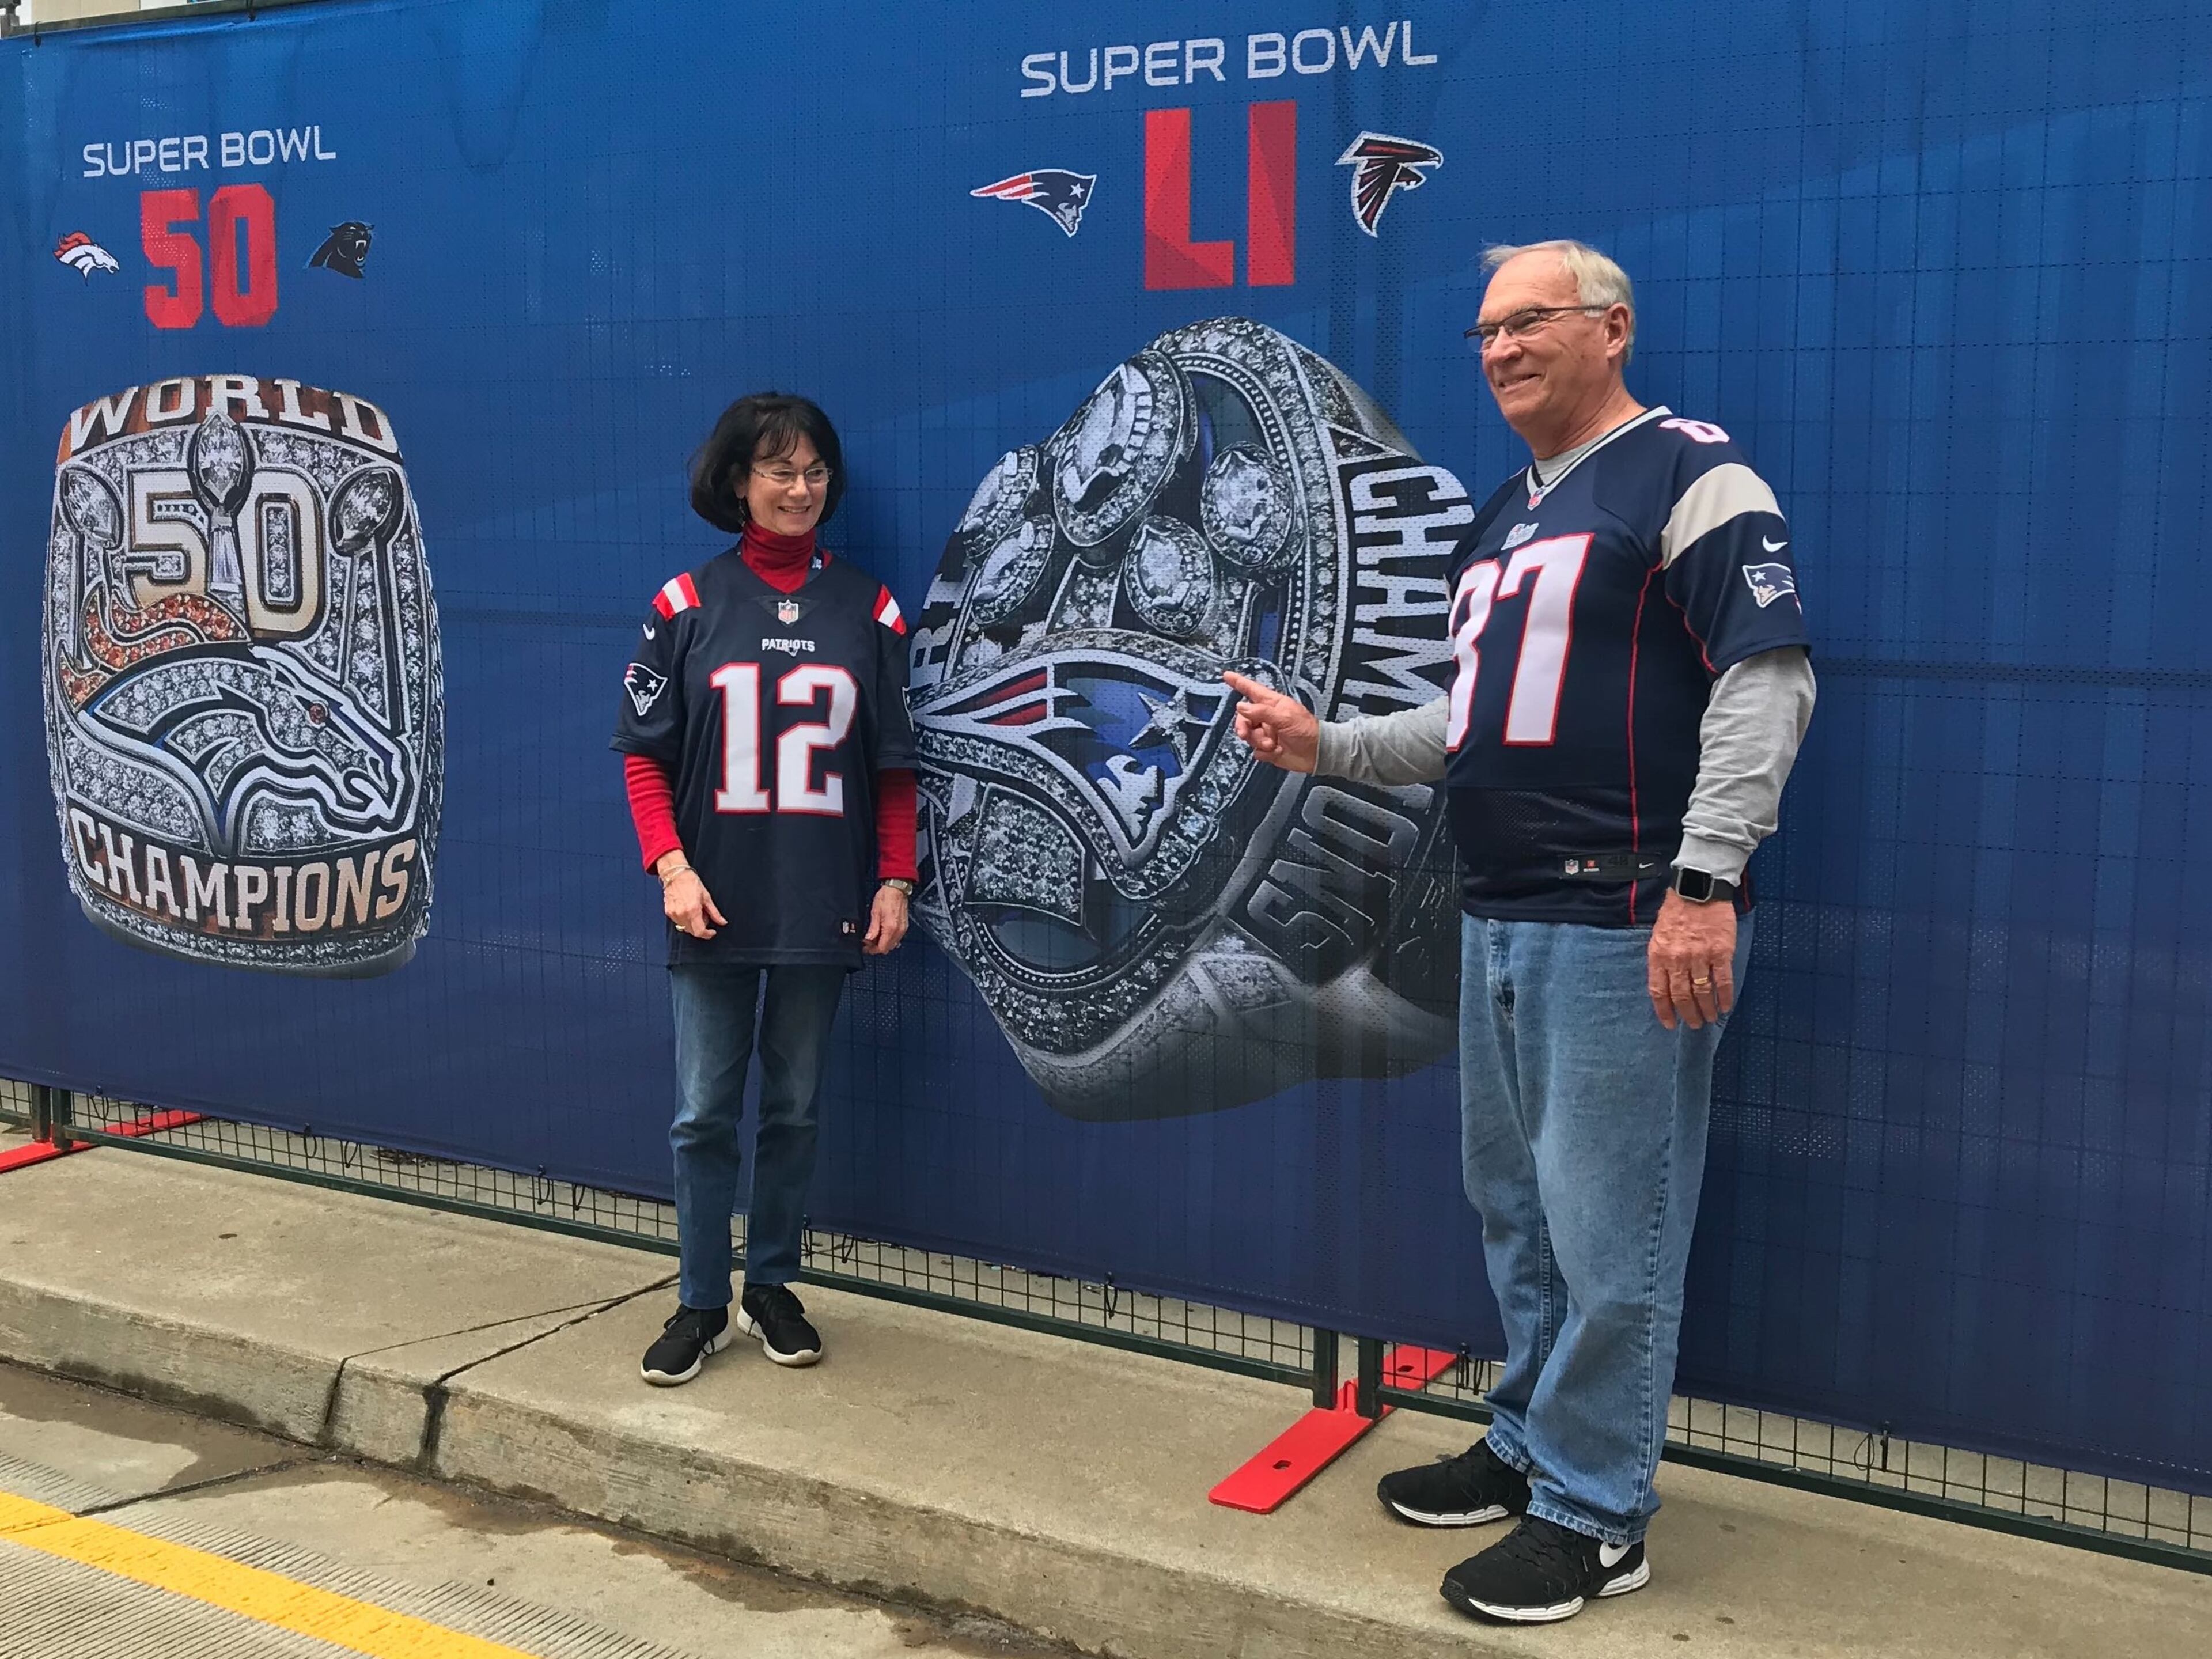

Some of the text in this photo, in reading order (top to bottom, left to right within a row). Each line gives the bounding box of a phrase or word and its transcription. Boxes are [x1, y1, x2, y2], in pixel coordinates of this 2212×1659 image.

[1020, 20, 1438, 98] SUPER BOWL
[83, 124, 337, 177] SUPER BOWL
[1144, 100, 1297, 290] LI
[140, 183, 279, 329] 50
[69, 374, 403, 454] WORLD
[126, 463, 324, 634] 50
[762, 638, 816, 652] PATRIOTS
[1445, 532, 1595, 752] 87
[709, 662, 858, 817] 12
[69, 806, 416, 932] CHAMPIONS
